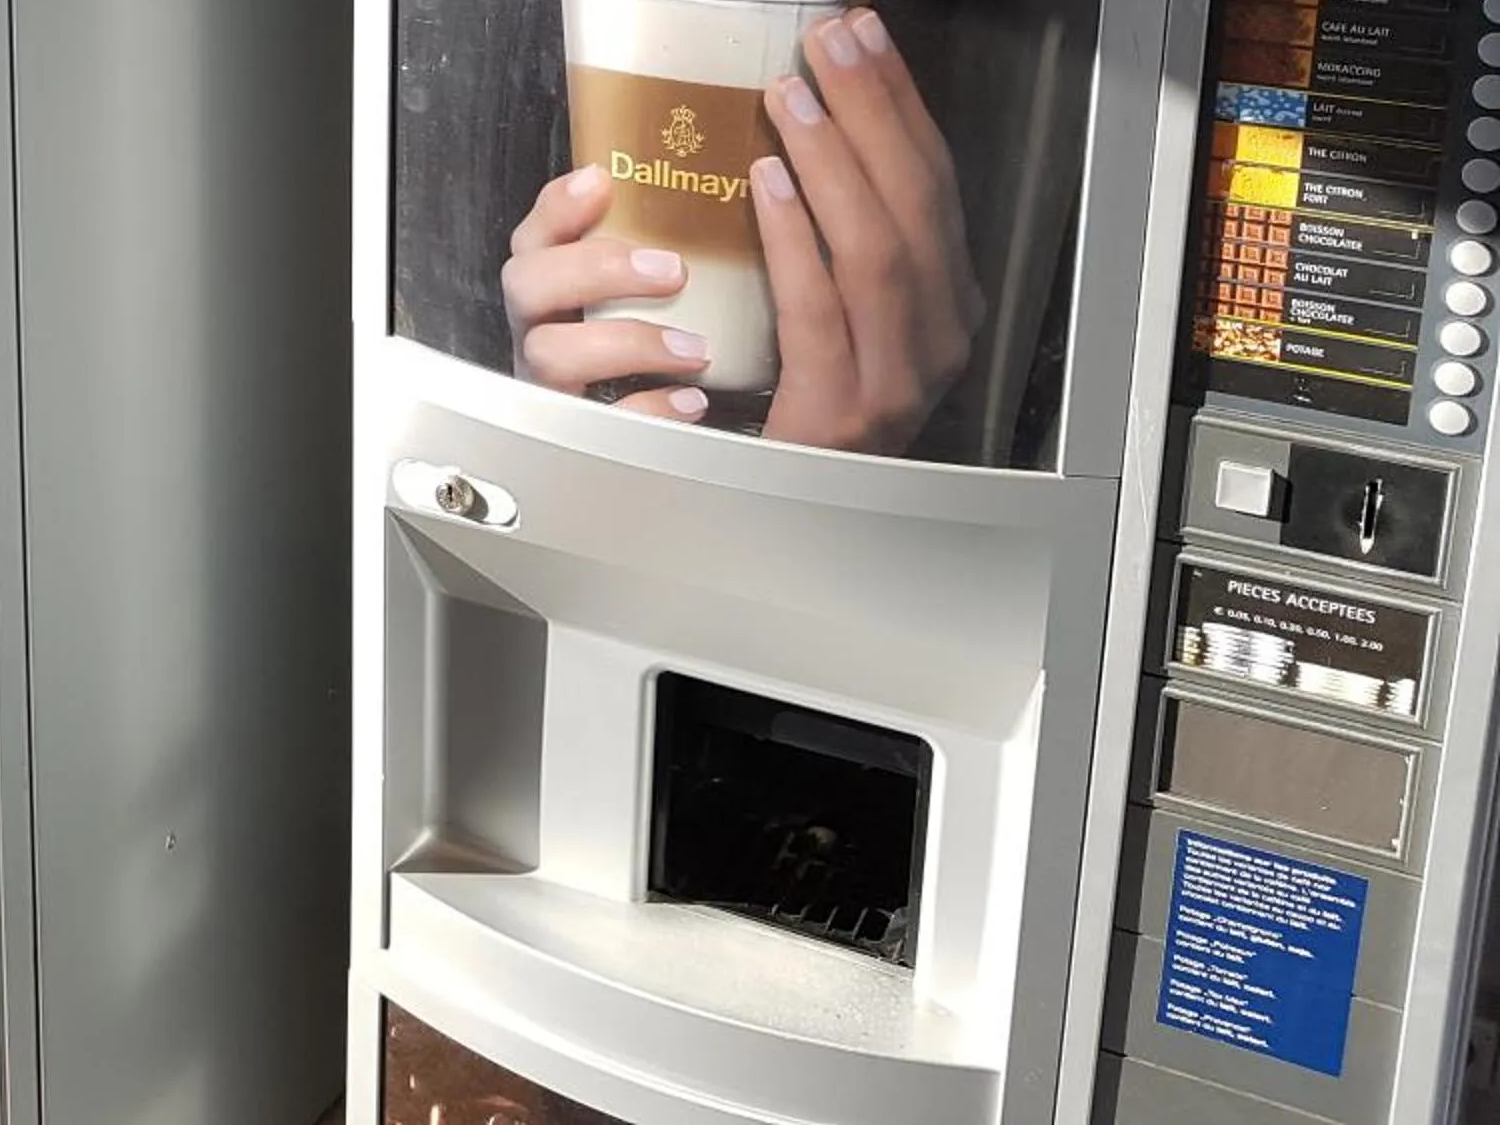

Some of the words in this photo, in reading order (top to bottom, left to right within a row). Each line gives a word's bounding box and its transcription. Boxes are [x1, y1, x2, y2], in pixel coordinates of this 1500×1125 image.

[1308, 146, 1328, 158] THE
[611, 150, 750, 202] Dallmayr
[1304, 182, 1323, 193] THE
[1325, 185, 1363, 198] CITRON
[1299, 222, 1345, 237] BOISSON
[1295, 262, 1349, 278] CHOCOLAT
[1293, 273, 1309, 282] AU
[1311, 275, 1333, 286] LAIT
[1227, 579, 1282, 603] PIECES
[1285, 592, 1376, 625] ACCEPTEES
